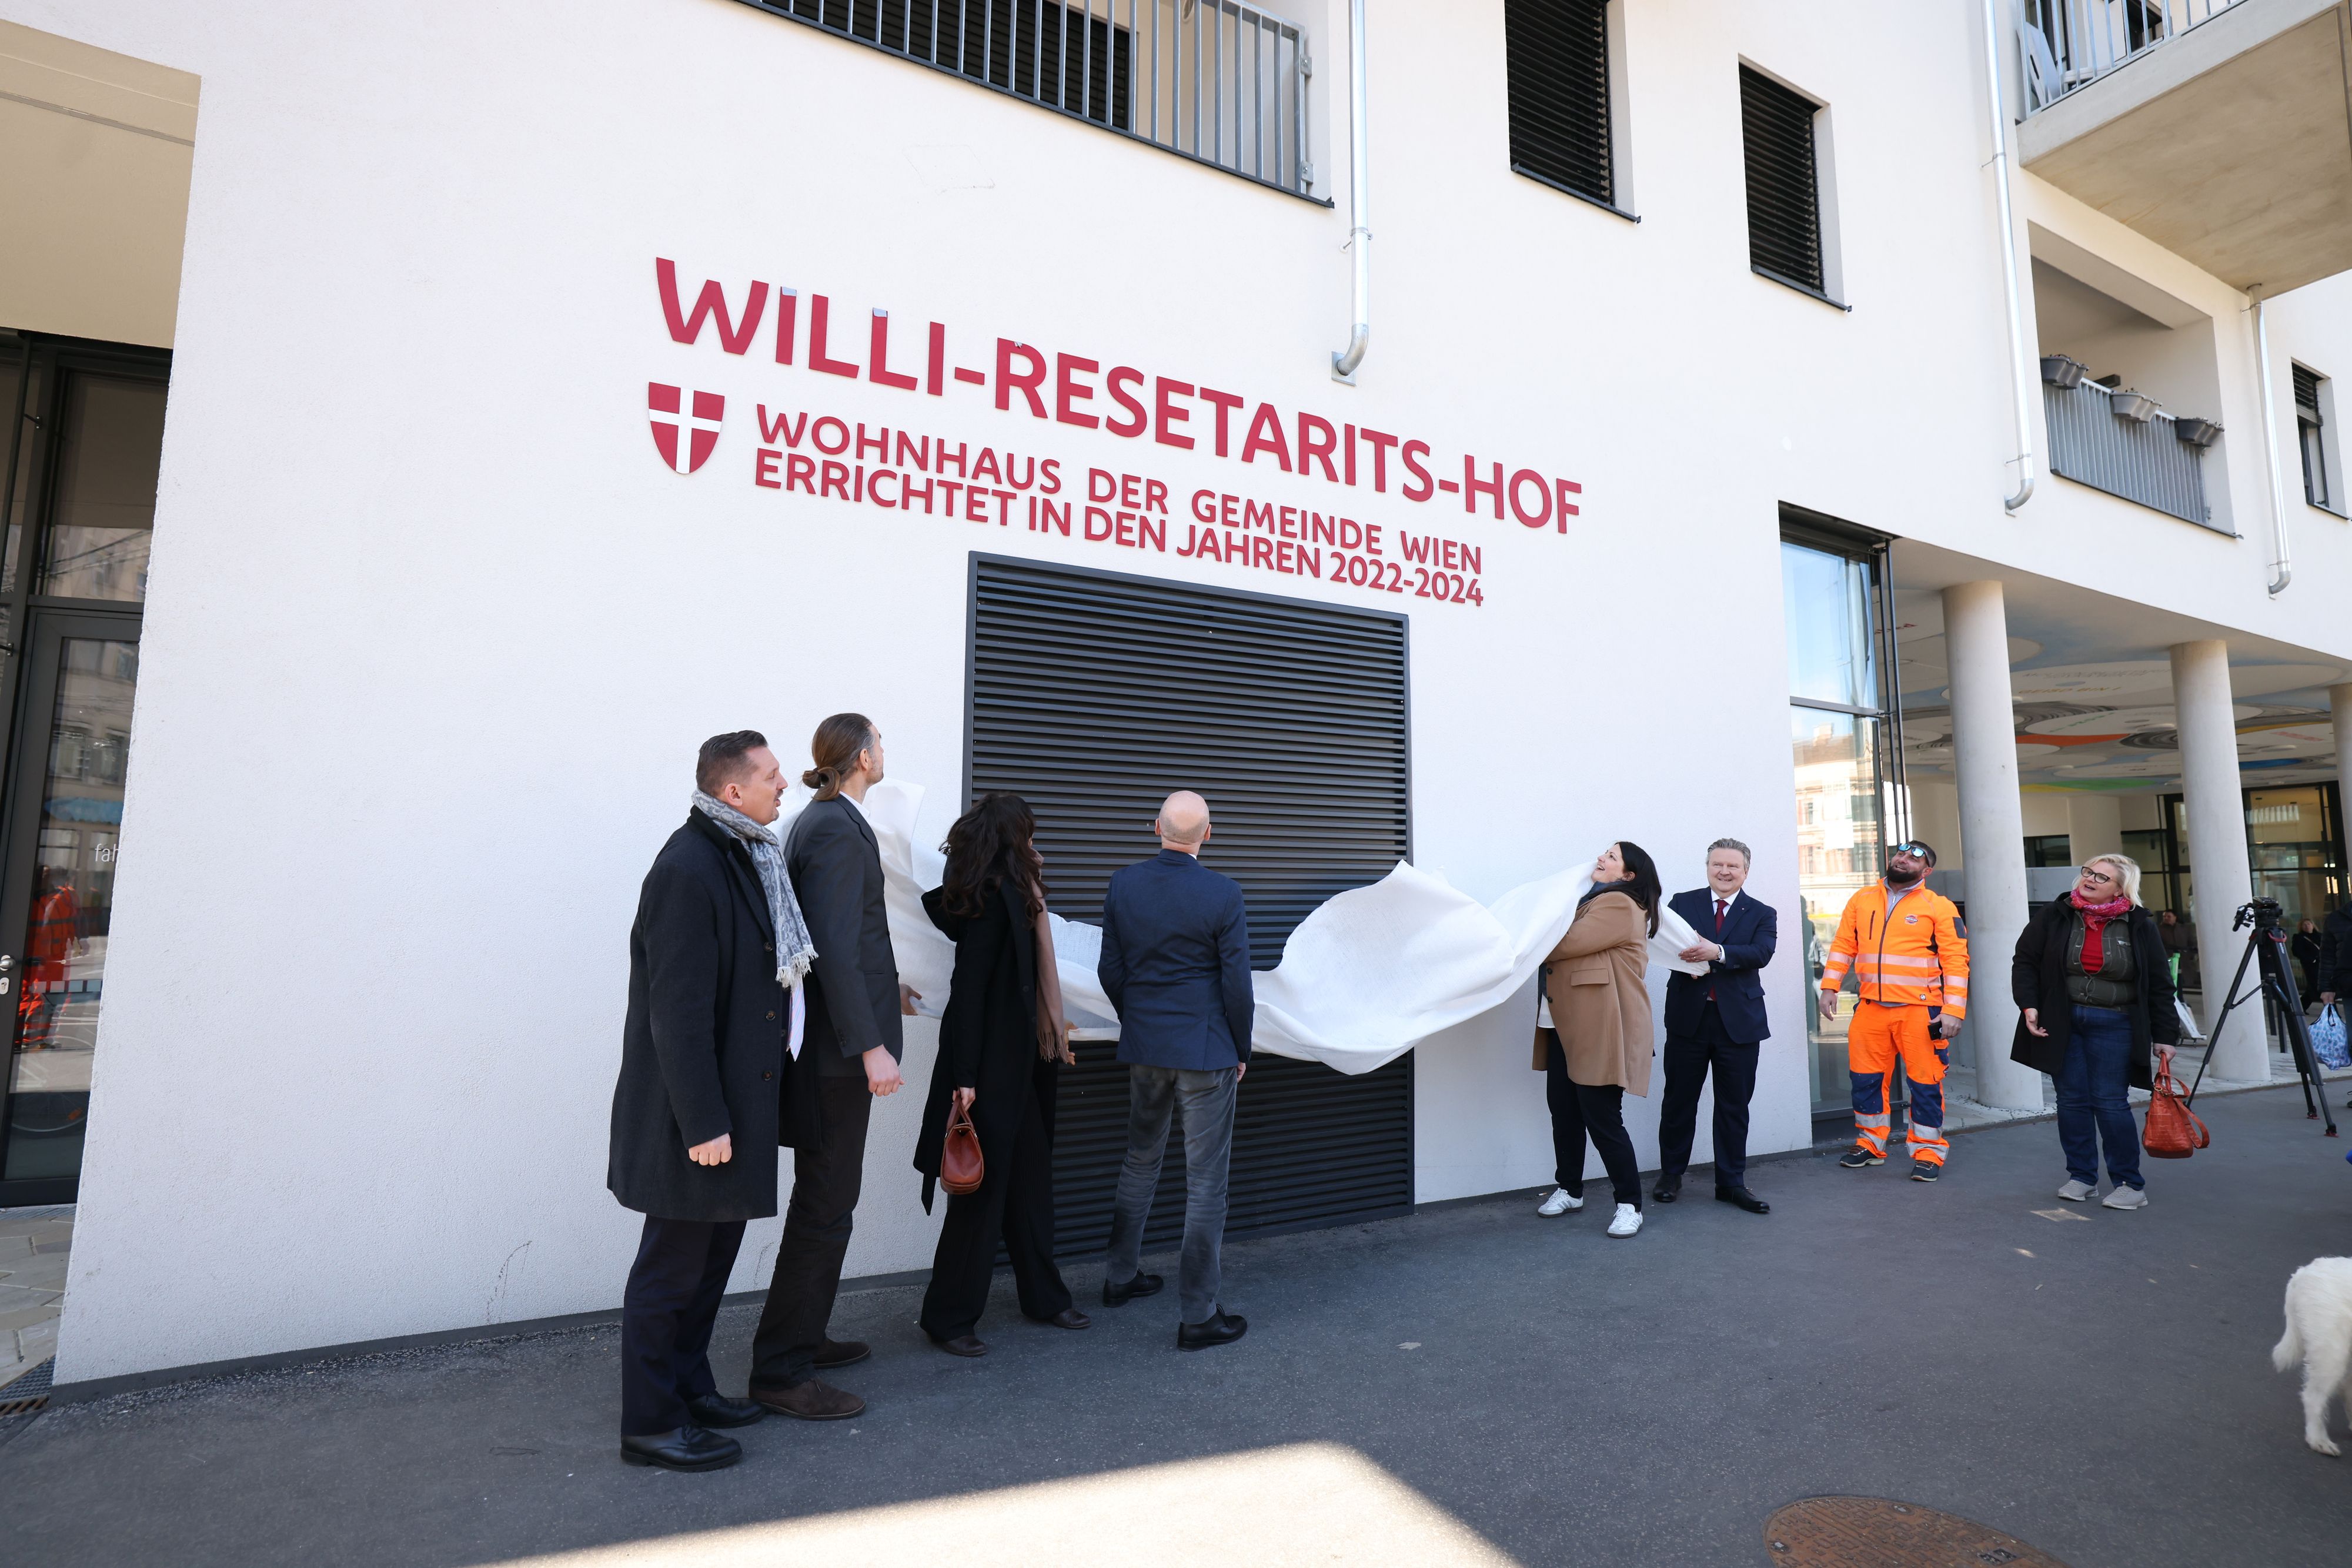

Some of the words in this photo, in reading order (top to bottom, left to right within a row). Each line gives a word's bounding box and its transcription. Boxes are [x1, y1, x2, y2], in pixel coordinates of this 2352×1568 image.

[655, 256, 1582, 534] WILLI-RESETARITS-HOF
[755, 447, 1018, 526] ERRICHTET
[1028, 495, 1072, 537] IN
[1084, 505, 1167, 553] DEN
[1176, 524, 1321, 579] JAHREN
[1329, 551, 1484, 607] 2022-2024
[756, 403, 1062, 495] WOHNHAUS
[1088, 467, 1169, 515] DER
[1191, 489, 1383, 556] GEMEINDE
[1400, 530, 1482, 575] WIEN
